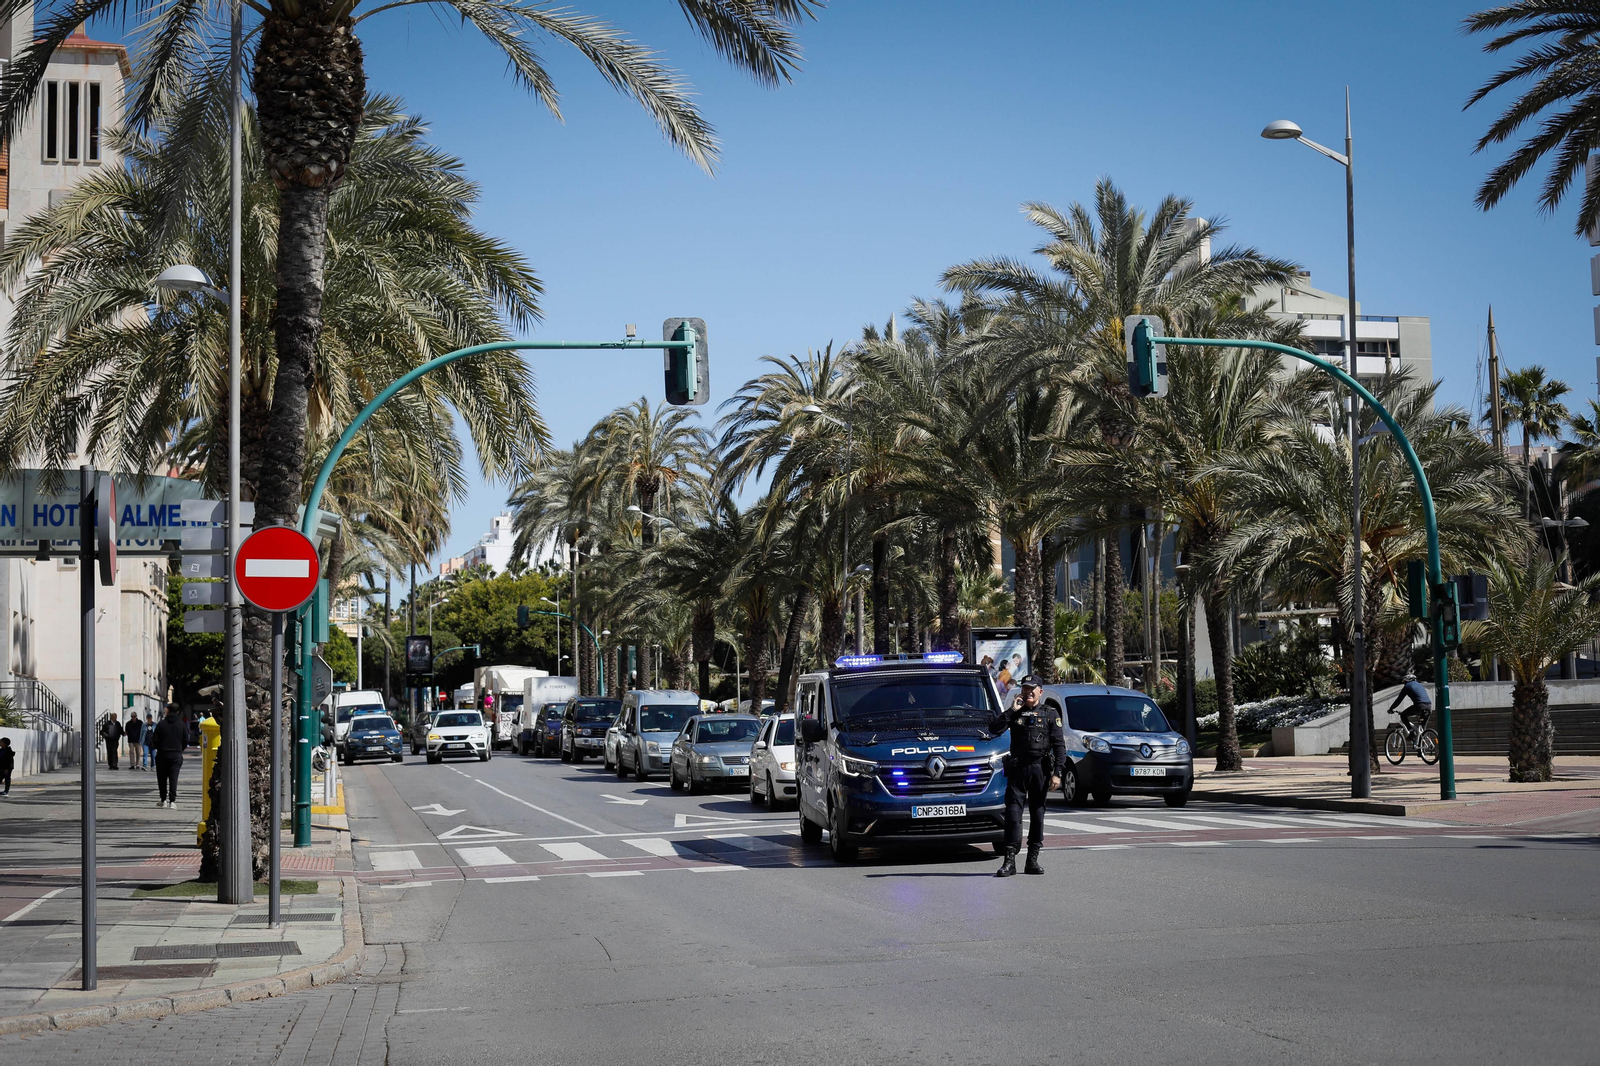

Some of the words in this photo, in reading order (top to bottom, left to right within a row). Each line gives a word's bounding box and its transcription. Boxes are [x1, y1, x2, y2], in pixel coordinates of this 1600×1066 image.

[33, 504, 99, 527] HOT
[891, 745, 958, 756] POLICIA
[917, 806, 965, 817] CNP3616BA
